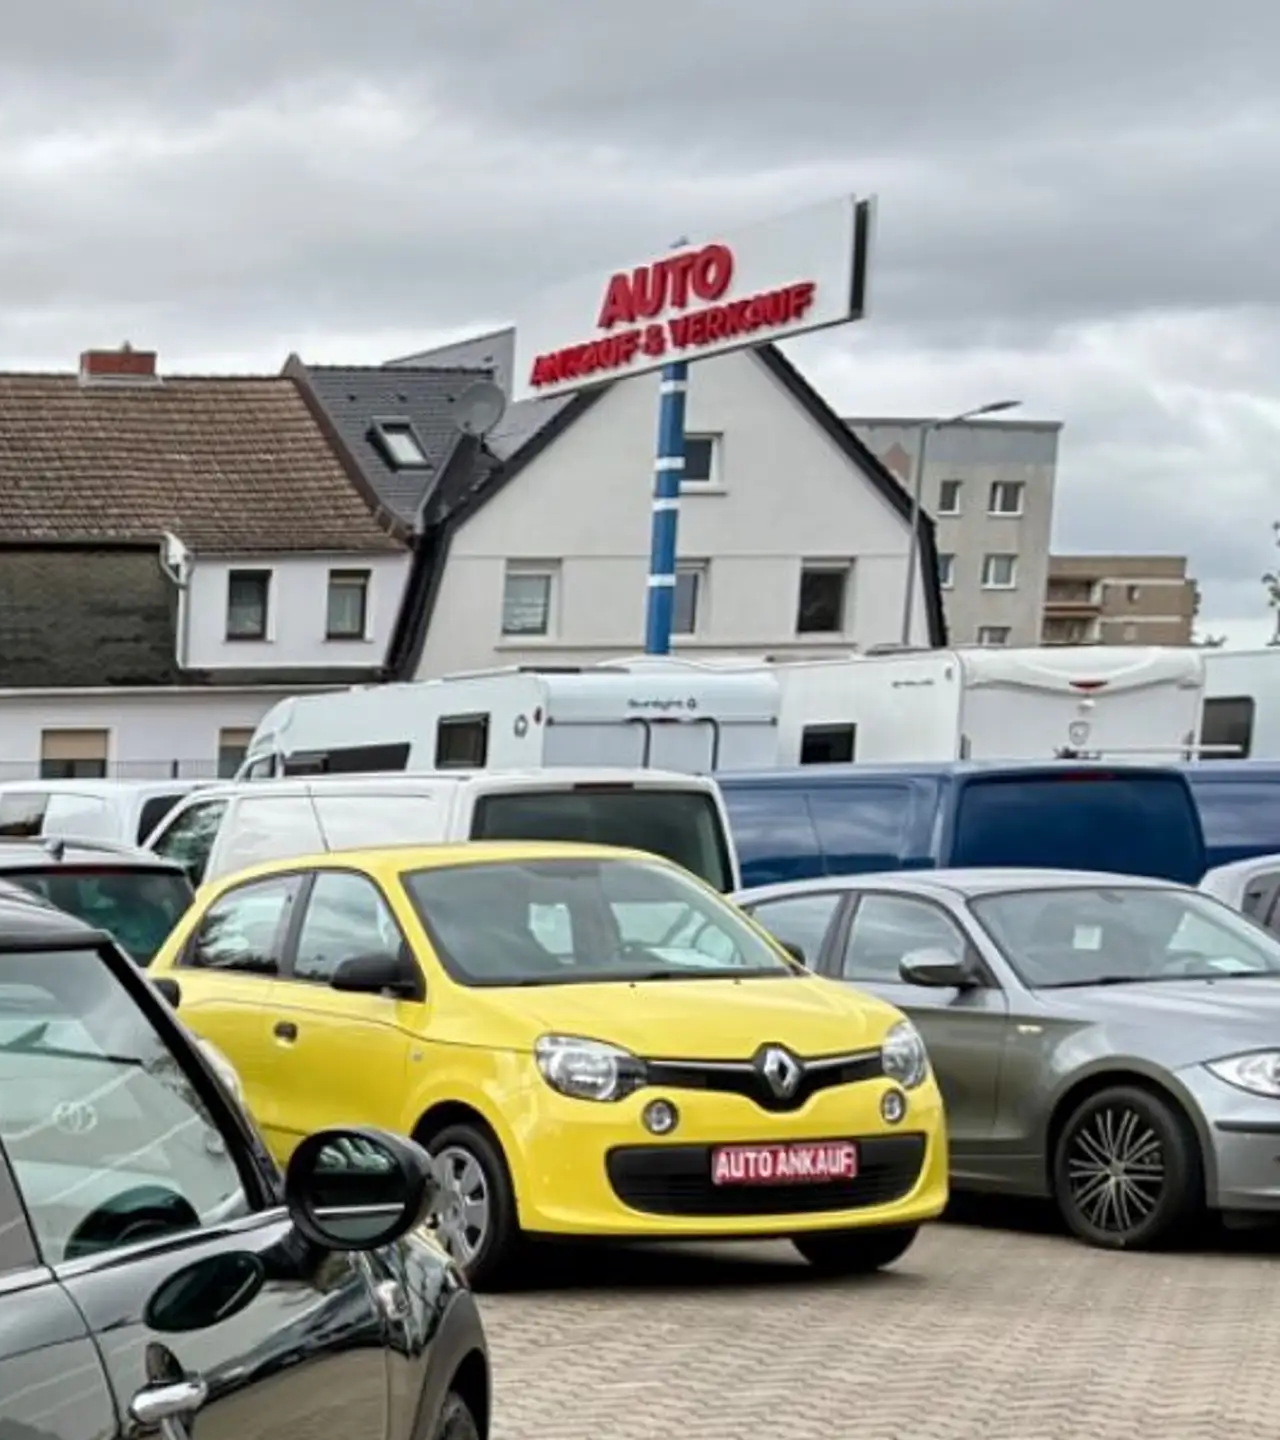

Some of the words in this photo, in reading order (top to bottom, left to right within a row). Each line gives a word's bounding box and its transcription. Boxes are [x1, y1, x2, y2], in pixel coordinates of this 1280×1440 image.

[597, 244, 734, 328] AUTO
[530, 329, 641, 386] ANKAUF
[640, 324, 667, 357] &
[668, 282, 816, 349] VERKAUF
[715, 1151, 773, 1179] AUTO
[775, 1147, 856, 1177] ANKAUF
